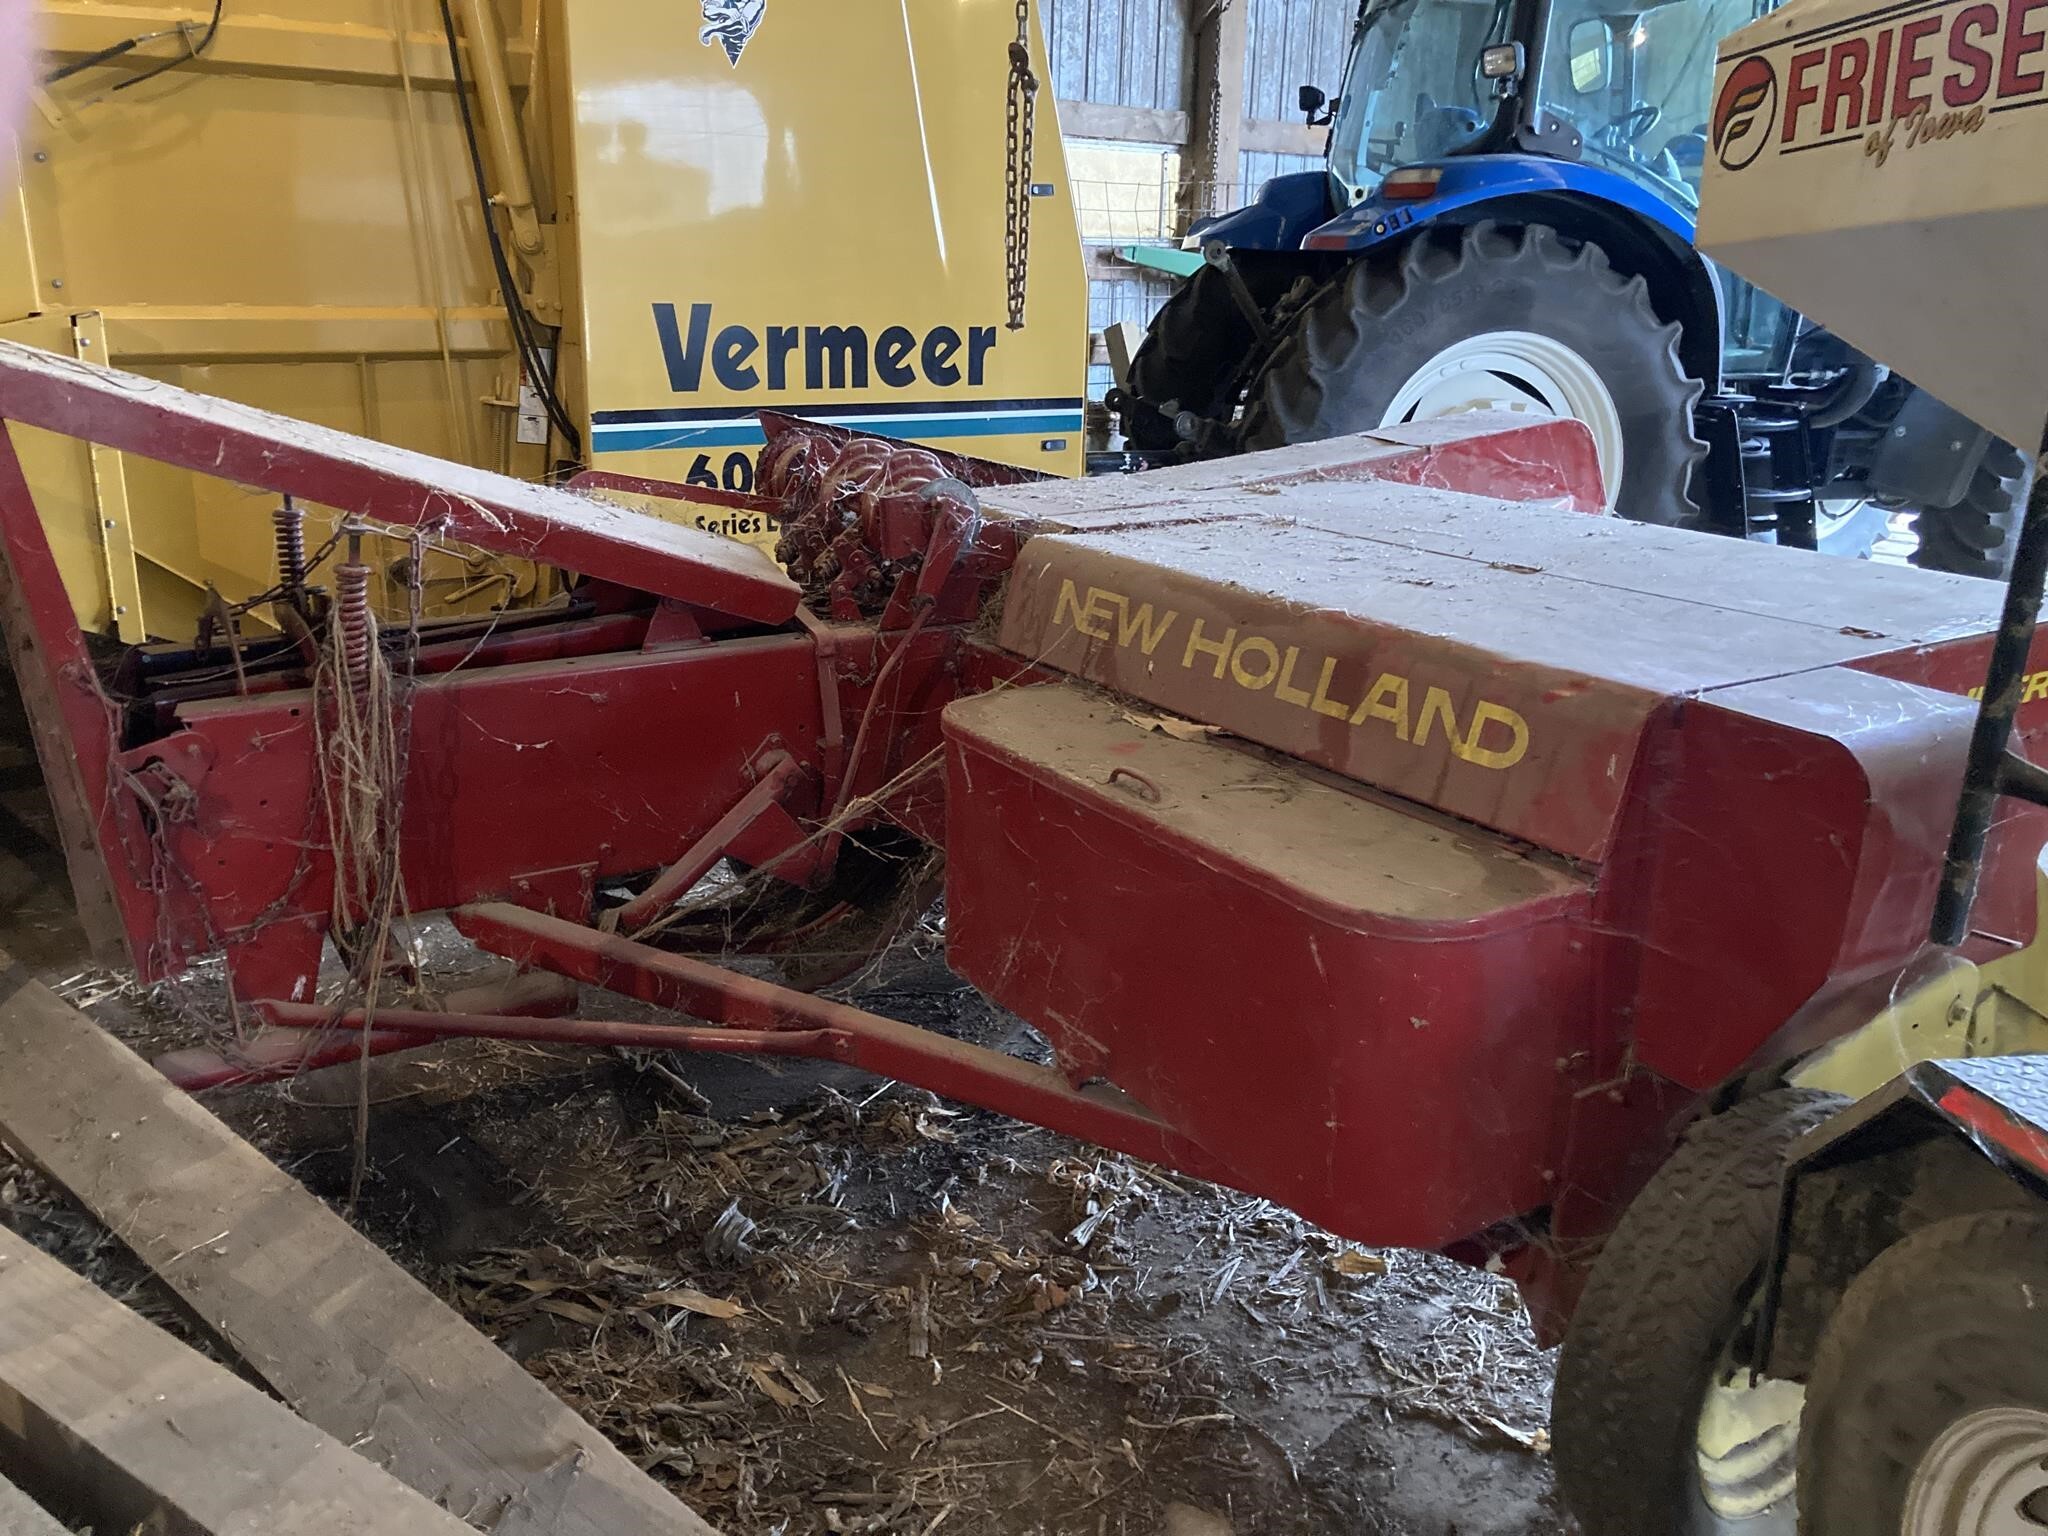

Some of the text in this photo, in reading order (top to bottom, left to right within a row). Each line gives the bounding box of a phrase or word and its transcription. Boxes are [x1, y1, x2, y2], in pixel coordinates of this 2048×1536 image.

[1864, 104, 1985, 168] of Iowa
[652, 303, 996, 392] Vermeer
[695, 513, 761, 535] Series
[1052, 578, 1530, 770] NEW HOLLAND
